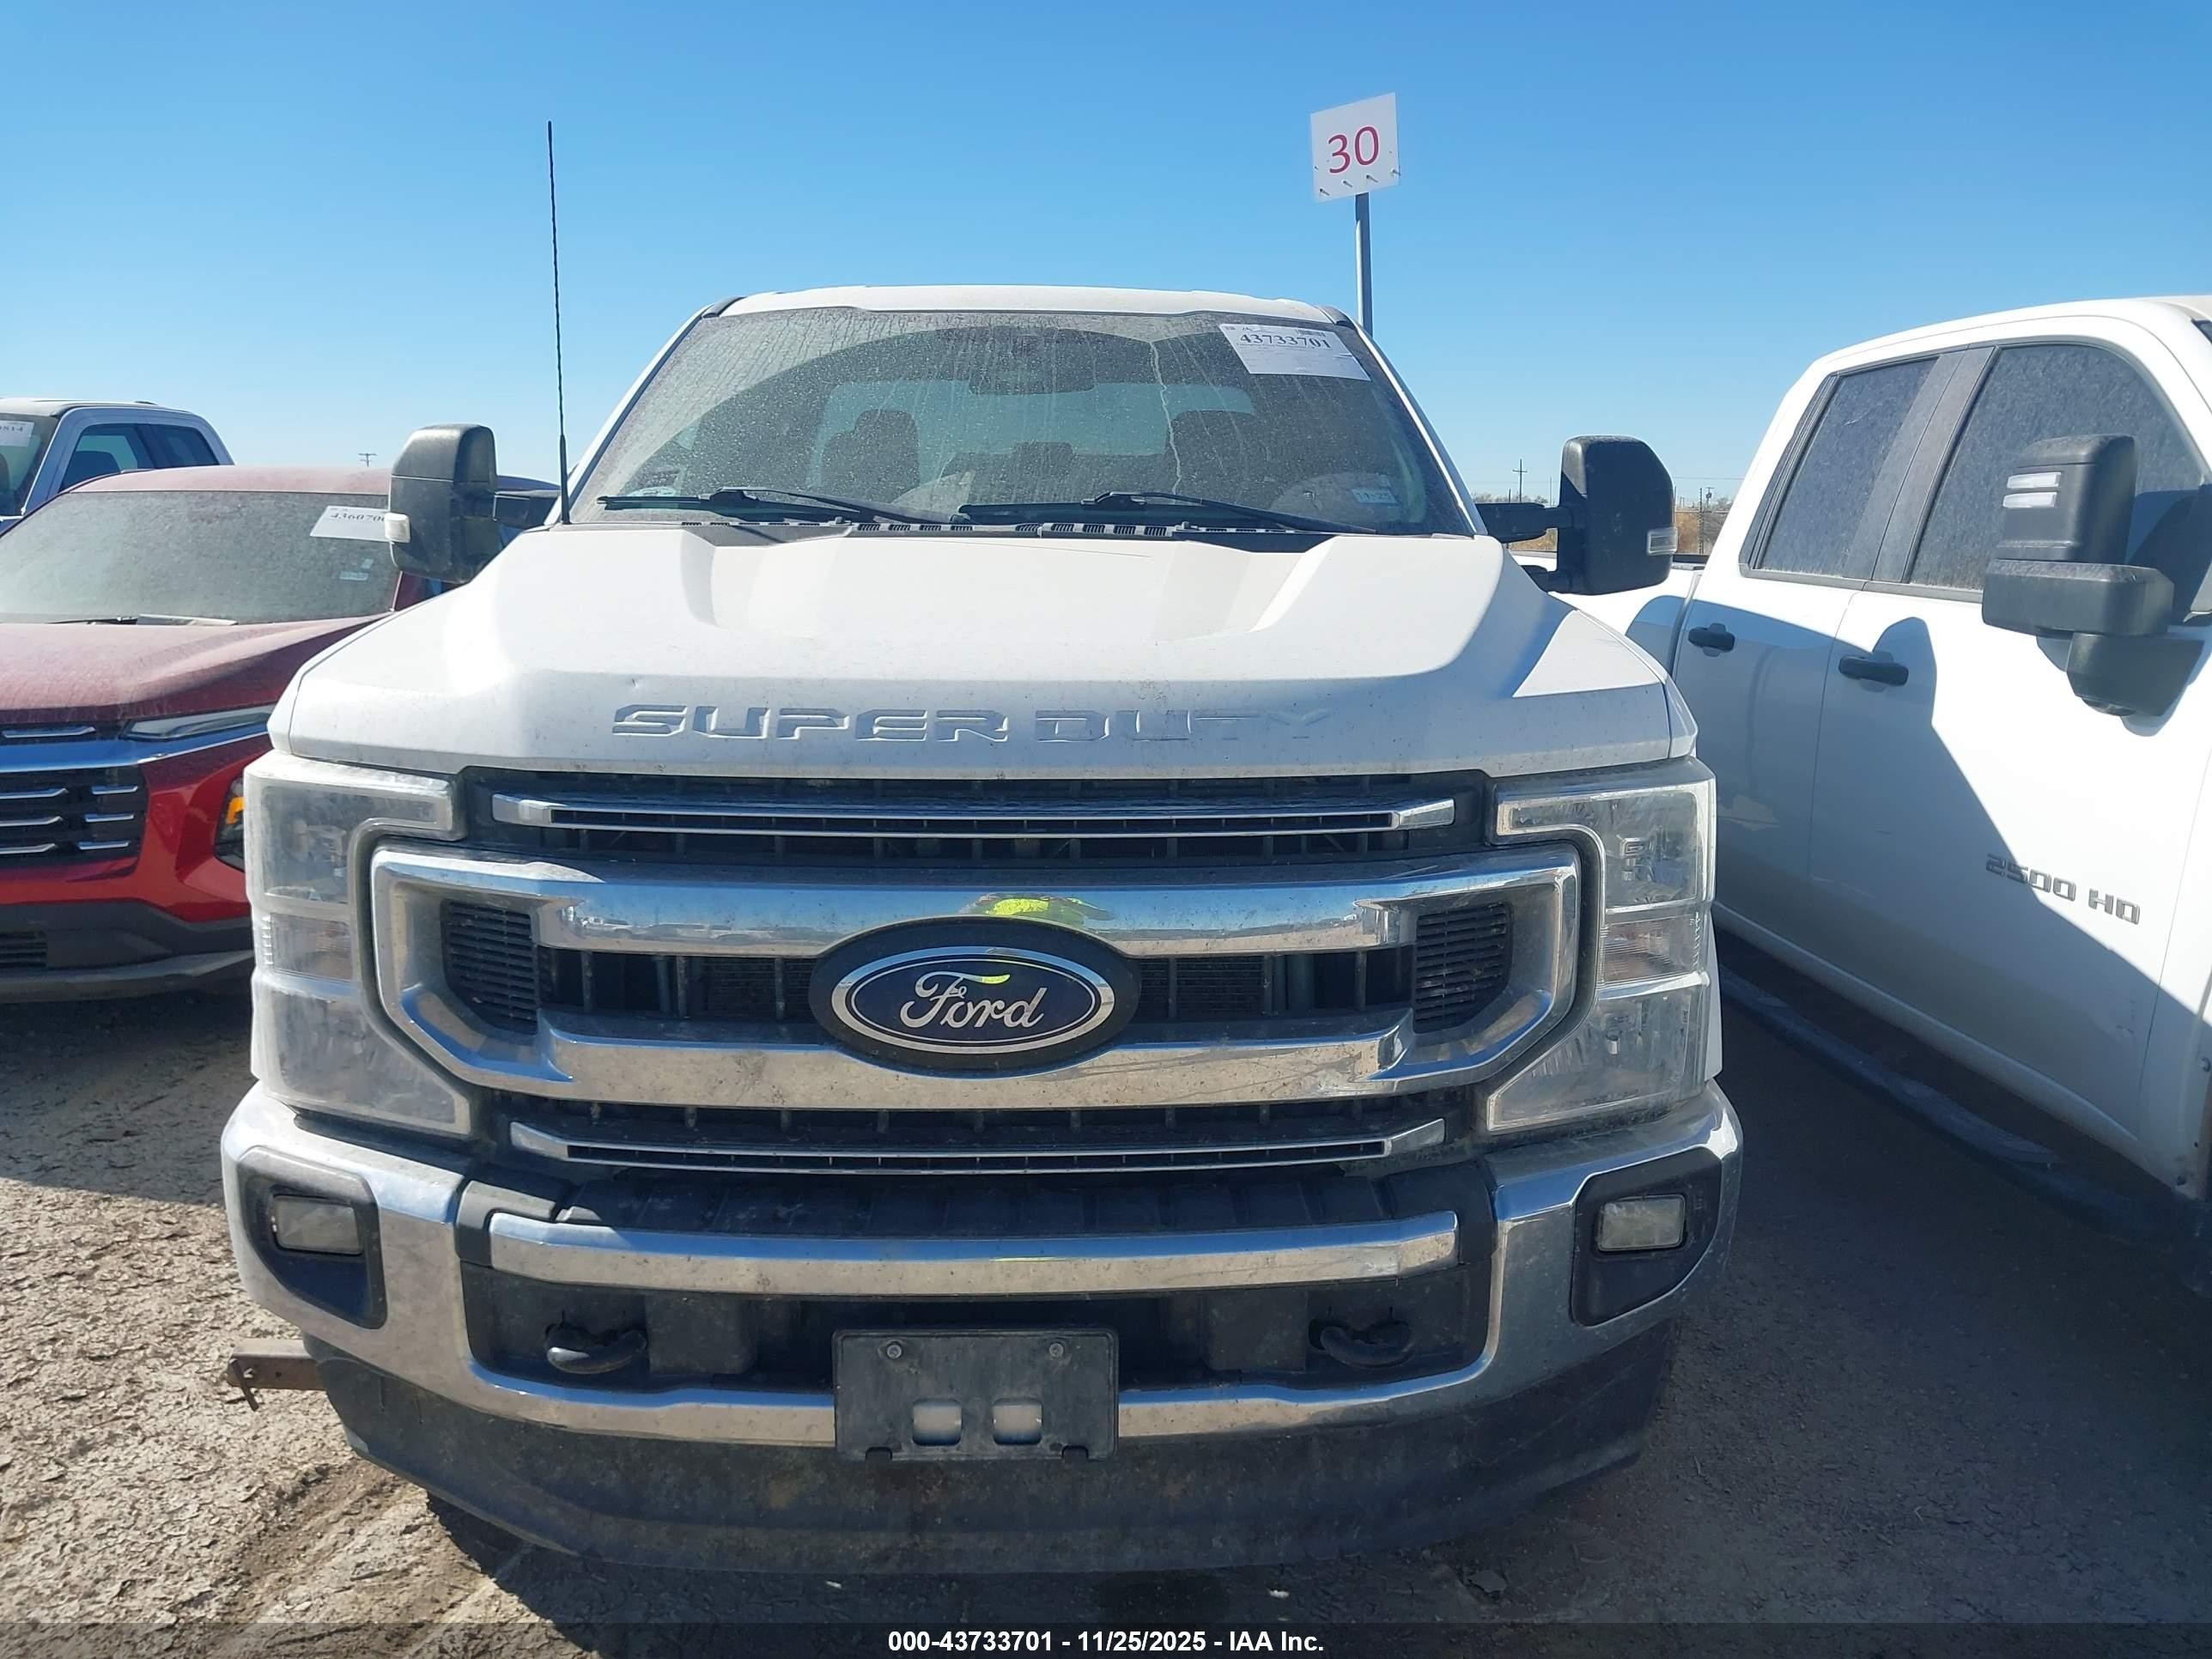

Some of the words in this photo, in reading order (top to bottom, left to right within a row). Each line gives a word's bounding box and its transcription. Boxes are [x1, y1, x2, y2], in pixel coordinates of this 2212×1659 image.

[1328, 125, 1380, 174] 30
[1240, 334, 1332, 349] 43733701
[611, 704, 1009, 743] SUPER
[1035, 708, 1331, 743] DUTY
[1985, 853, 2077, 902] 2500
[2087, 887, 2142, 926] HD
[900, 970, 1048, 1029] Ford
